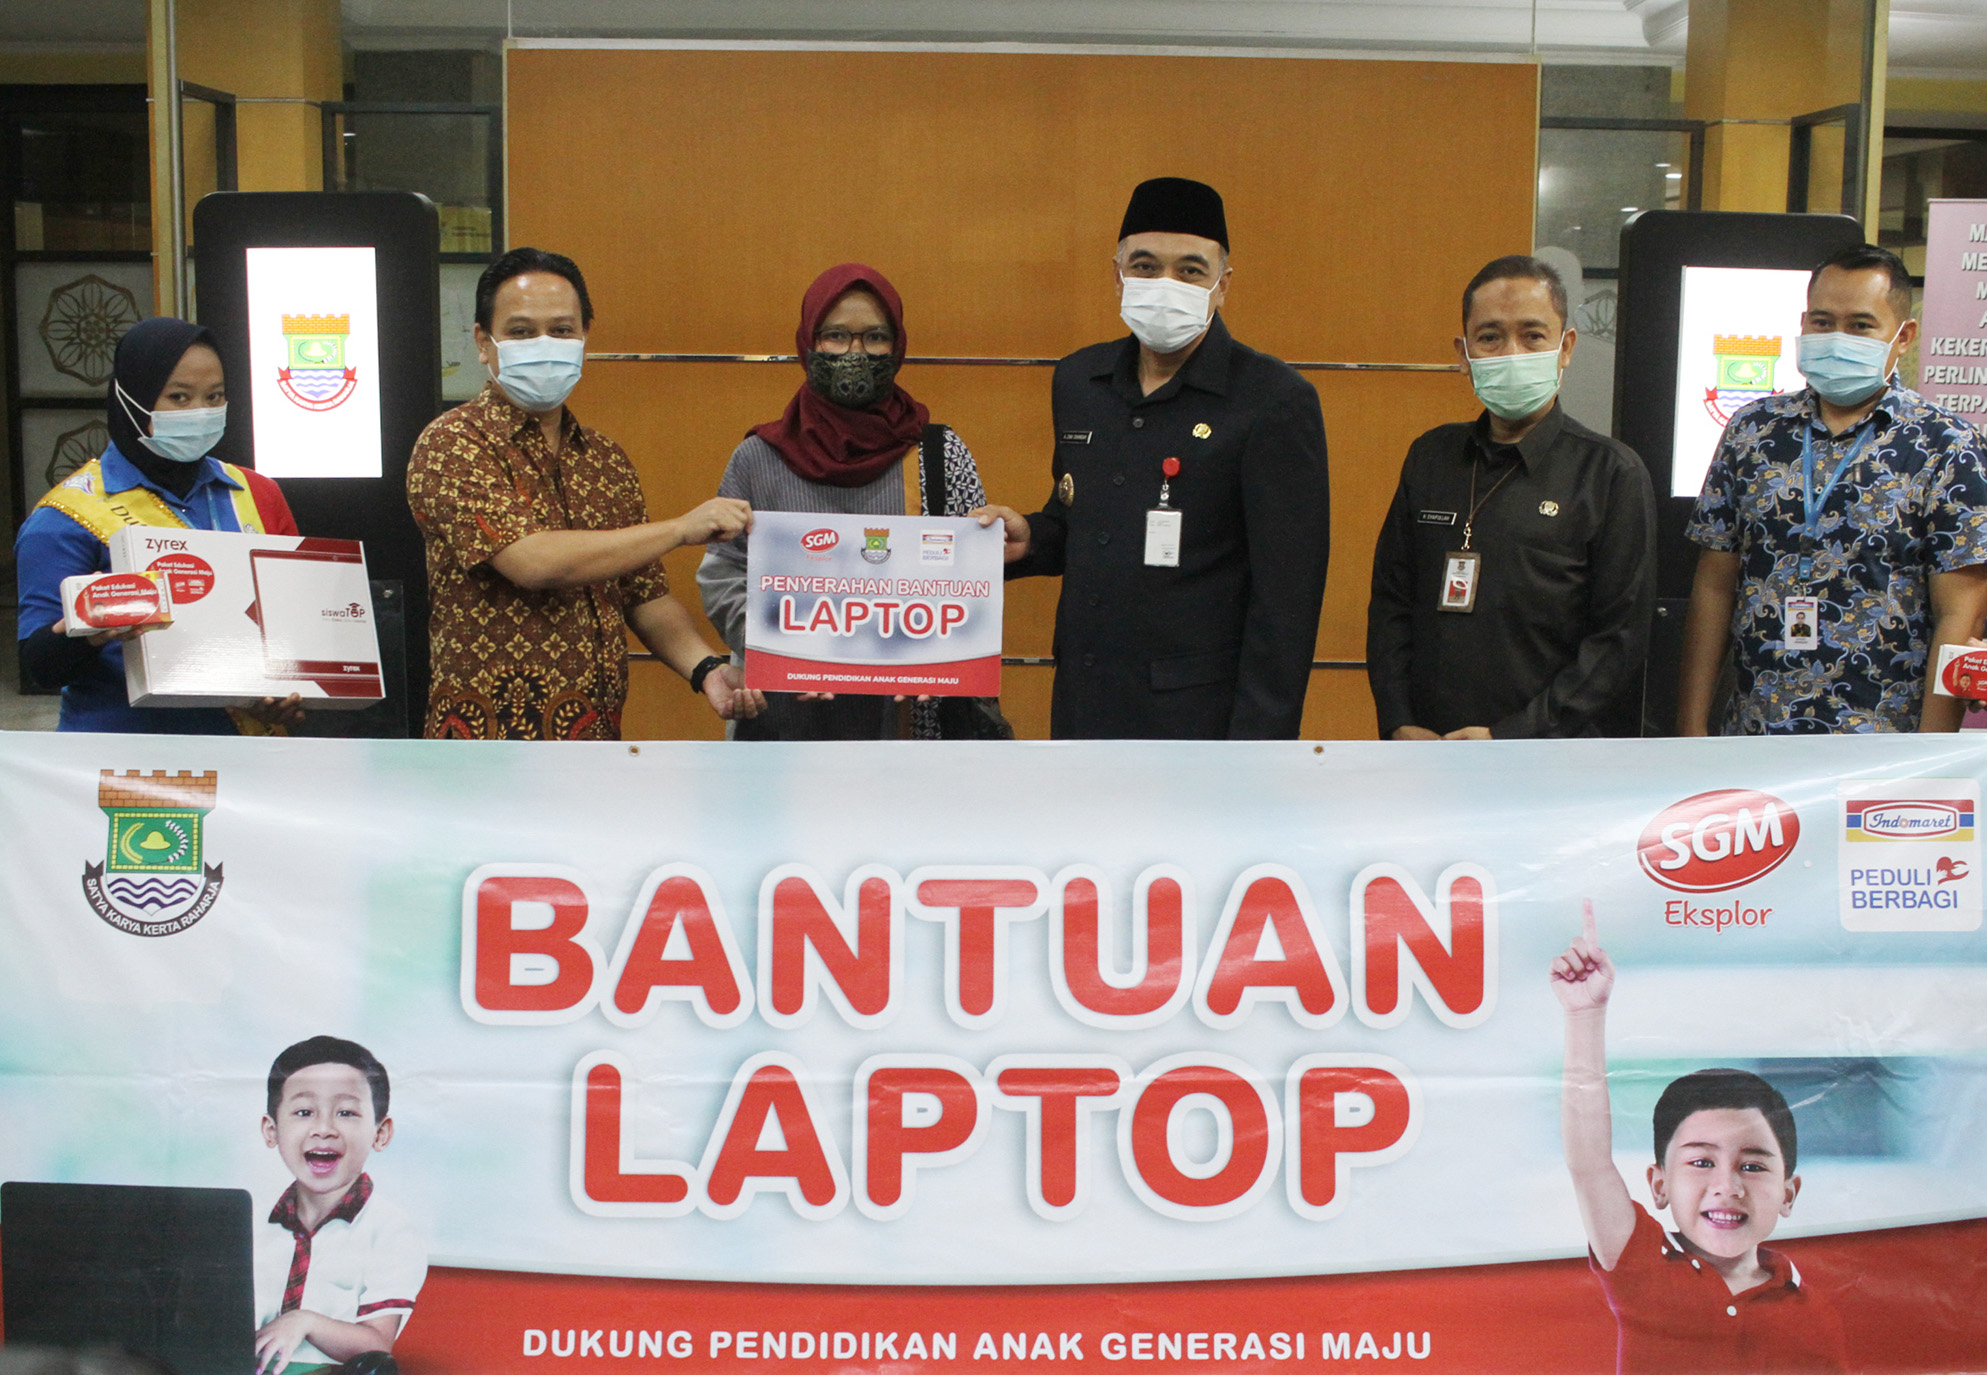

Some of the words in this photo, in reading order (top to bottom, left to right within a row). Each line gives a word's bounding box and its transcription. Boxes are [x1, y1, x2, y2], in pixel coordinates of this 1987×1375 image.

[145, 538, 188, 553] zyrex
[805, 531, 836, 549] SGM
[759, 574, 893, 596] PENYERAHAN
[896, 578, 990, 598] BANTUAN
[782, 597, 967, 636] LAPTOP
[787, 672, 821, 681] DUKUNG
[823, 674, 872, 683] PENDIDIKAN
[873, 676, 896, 684] ANAK
[897, 677, 936, 685] GENERASI
[1868, 812, 1952, 830] Indomaret
[1659, 801, 1785, 871] SGM
[1850, 868, 1932, 886] PEDULI
[87, 877, 108, 915] SATYA
[106, 908, 142, 934] KARYA
[142, 920, 182, 935] KERTA
[180, 880, 221, 927] RAHARJA
[1851, 889, 1958, 909] BERBAGI
[1664, 899, 1773, 934] Eksplor
[468, 869, 1491, 1023] BANTUAN
[578, 1057, 1416, 1213] LAPTOP
[522, 1328, 694, 1358] DUKUNG
[709, 1330, 957, 1360] PENDIDIKAN
[972, 1331, 1085, 1360] ANAK
[1100, 1331, 1304, 1361] GENERASI
[1321, 1331, 1431, 1361] MAJU
